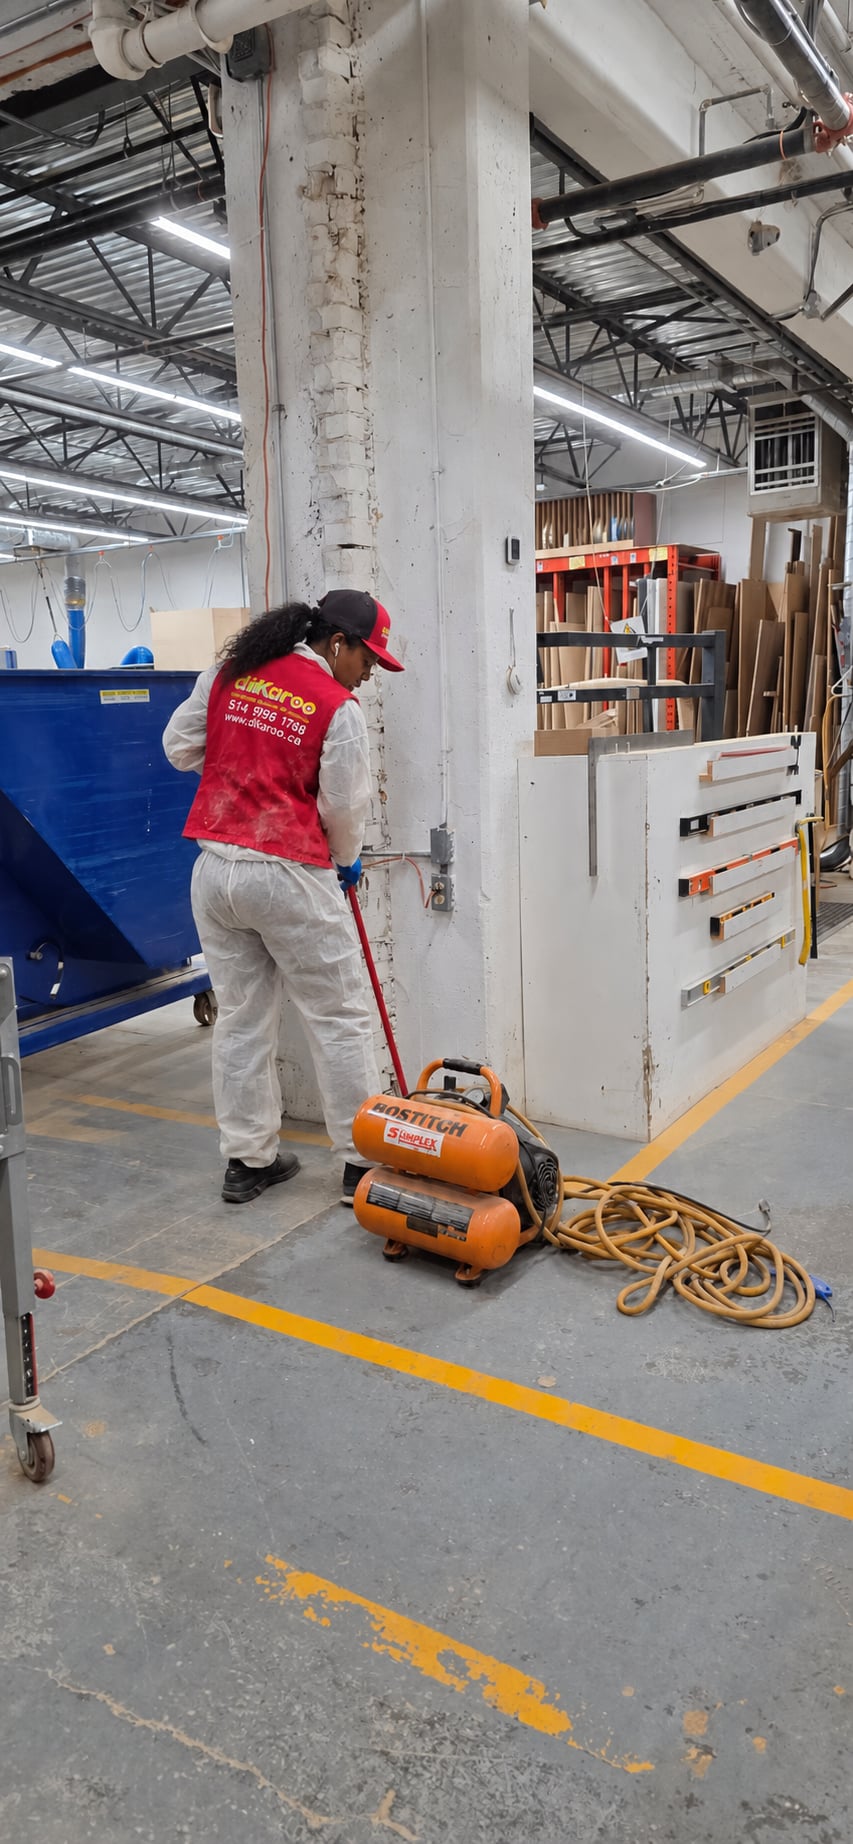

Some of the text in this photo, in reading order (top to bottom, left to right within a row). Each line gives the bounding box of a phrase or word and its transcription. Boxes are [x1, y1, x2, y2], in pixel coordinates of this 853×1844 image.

[228, 699, 249, 714] 514
[252, 706, 278, 722] 996
[281, 716, 307, 735] 1768
[371, 1102, 468, 1137] BOSTITCH
